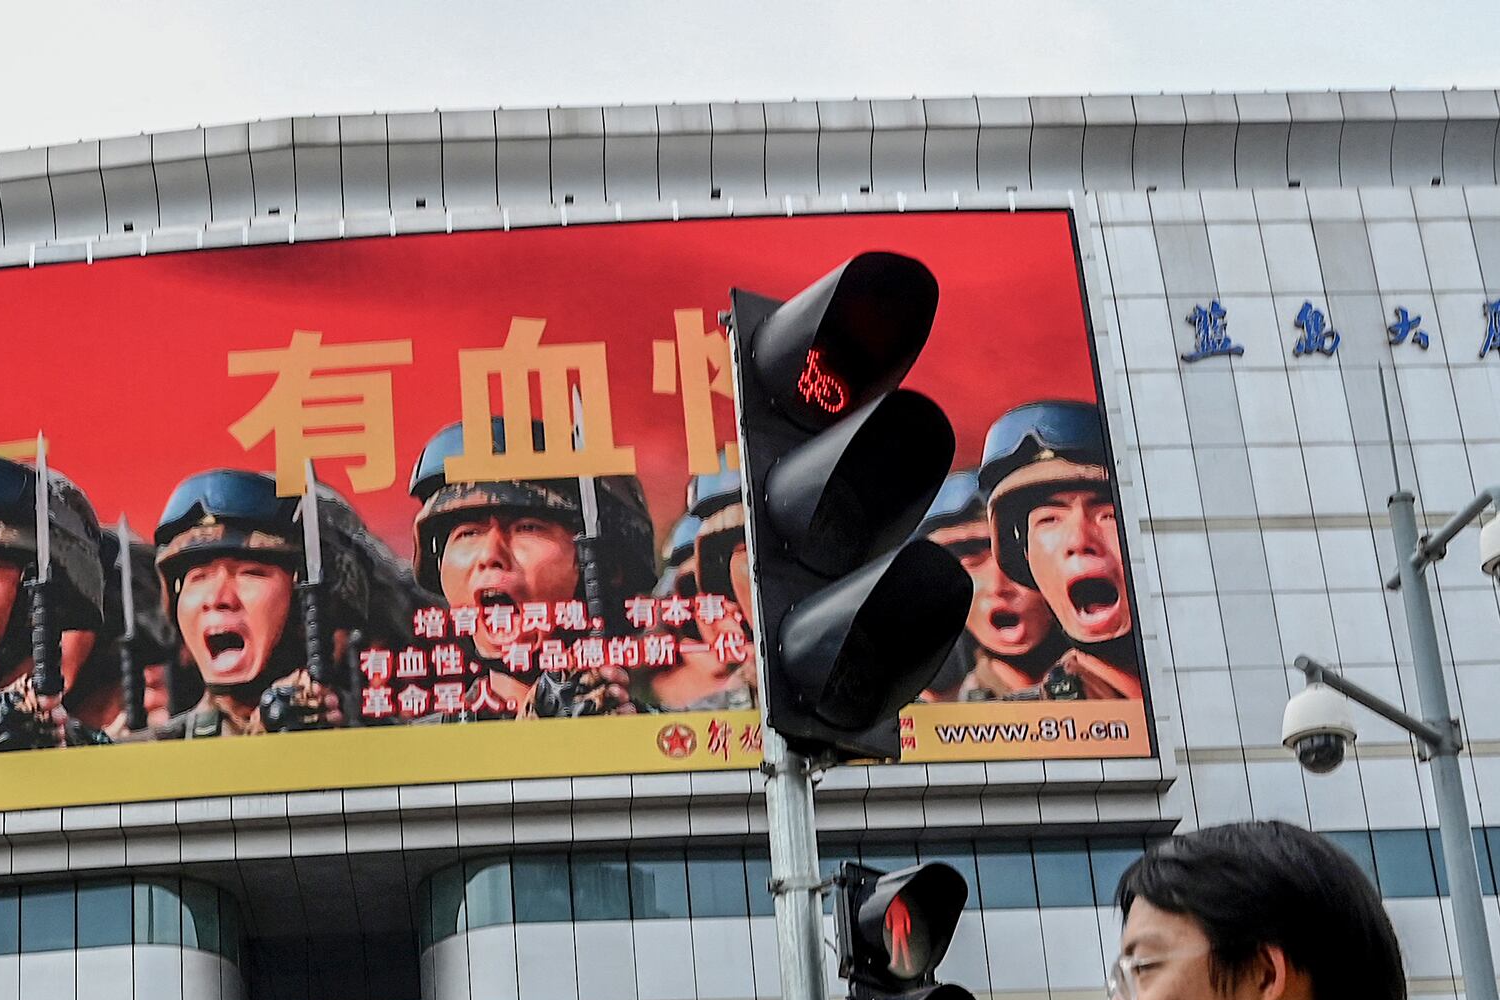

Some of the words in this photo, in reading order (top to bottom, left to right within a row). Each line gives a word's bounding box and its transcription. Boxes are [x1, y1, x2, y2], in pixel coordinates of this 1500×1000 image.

[360, 633, 747, 680] 有血性、有品德的新一代
[362, 680, 518, 716] 革命军人。
[936, 717, 1130, 744] www.81.cn
